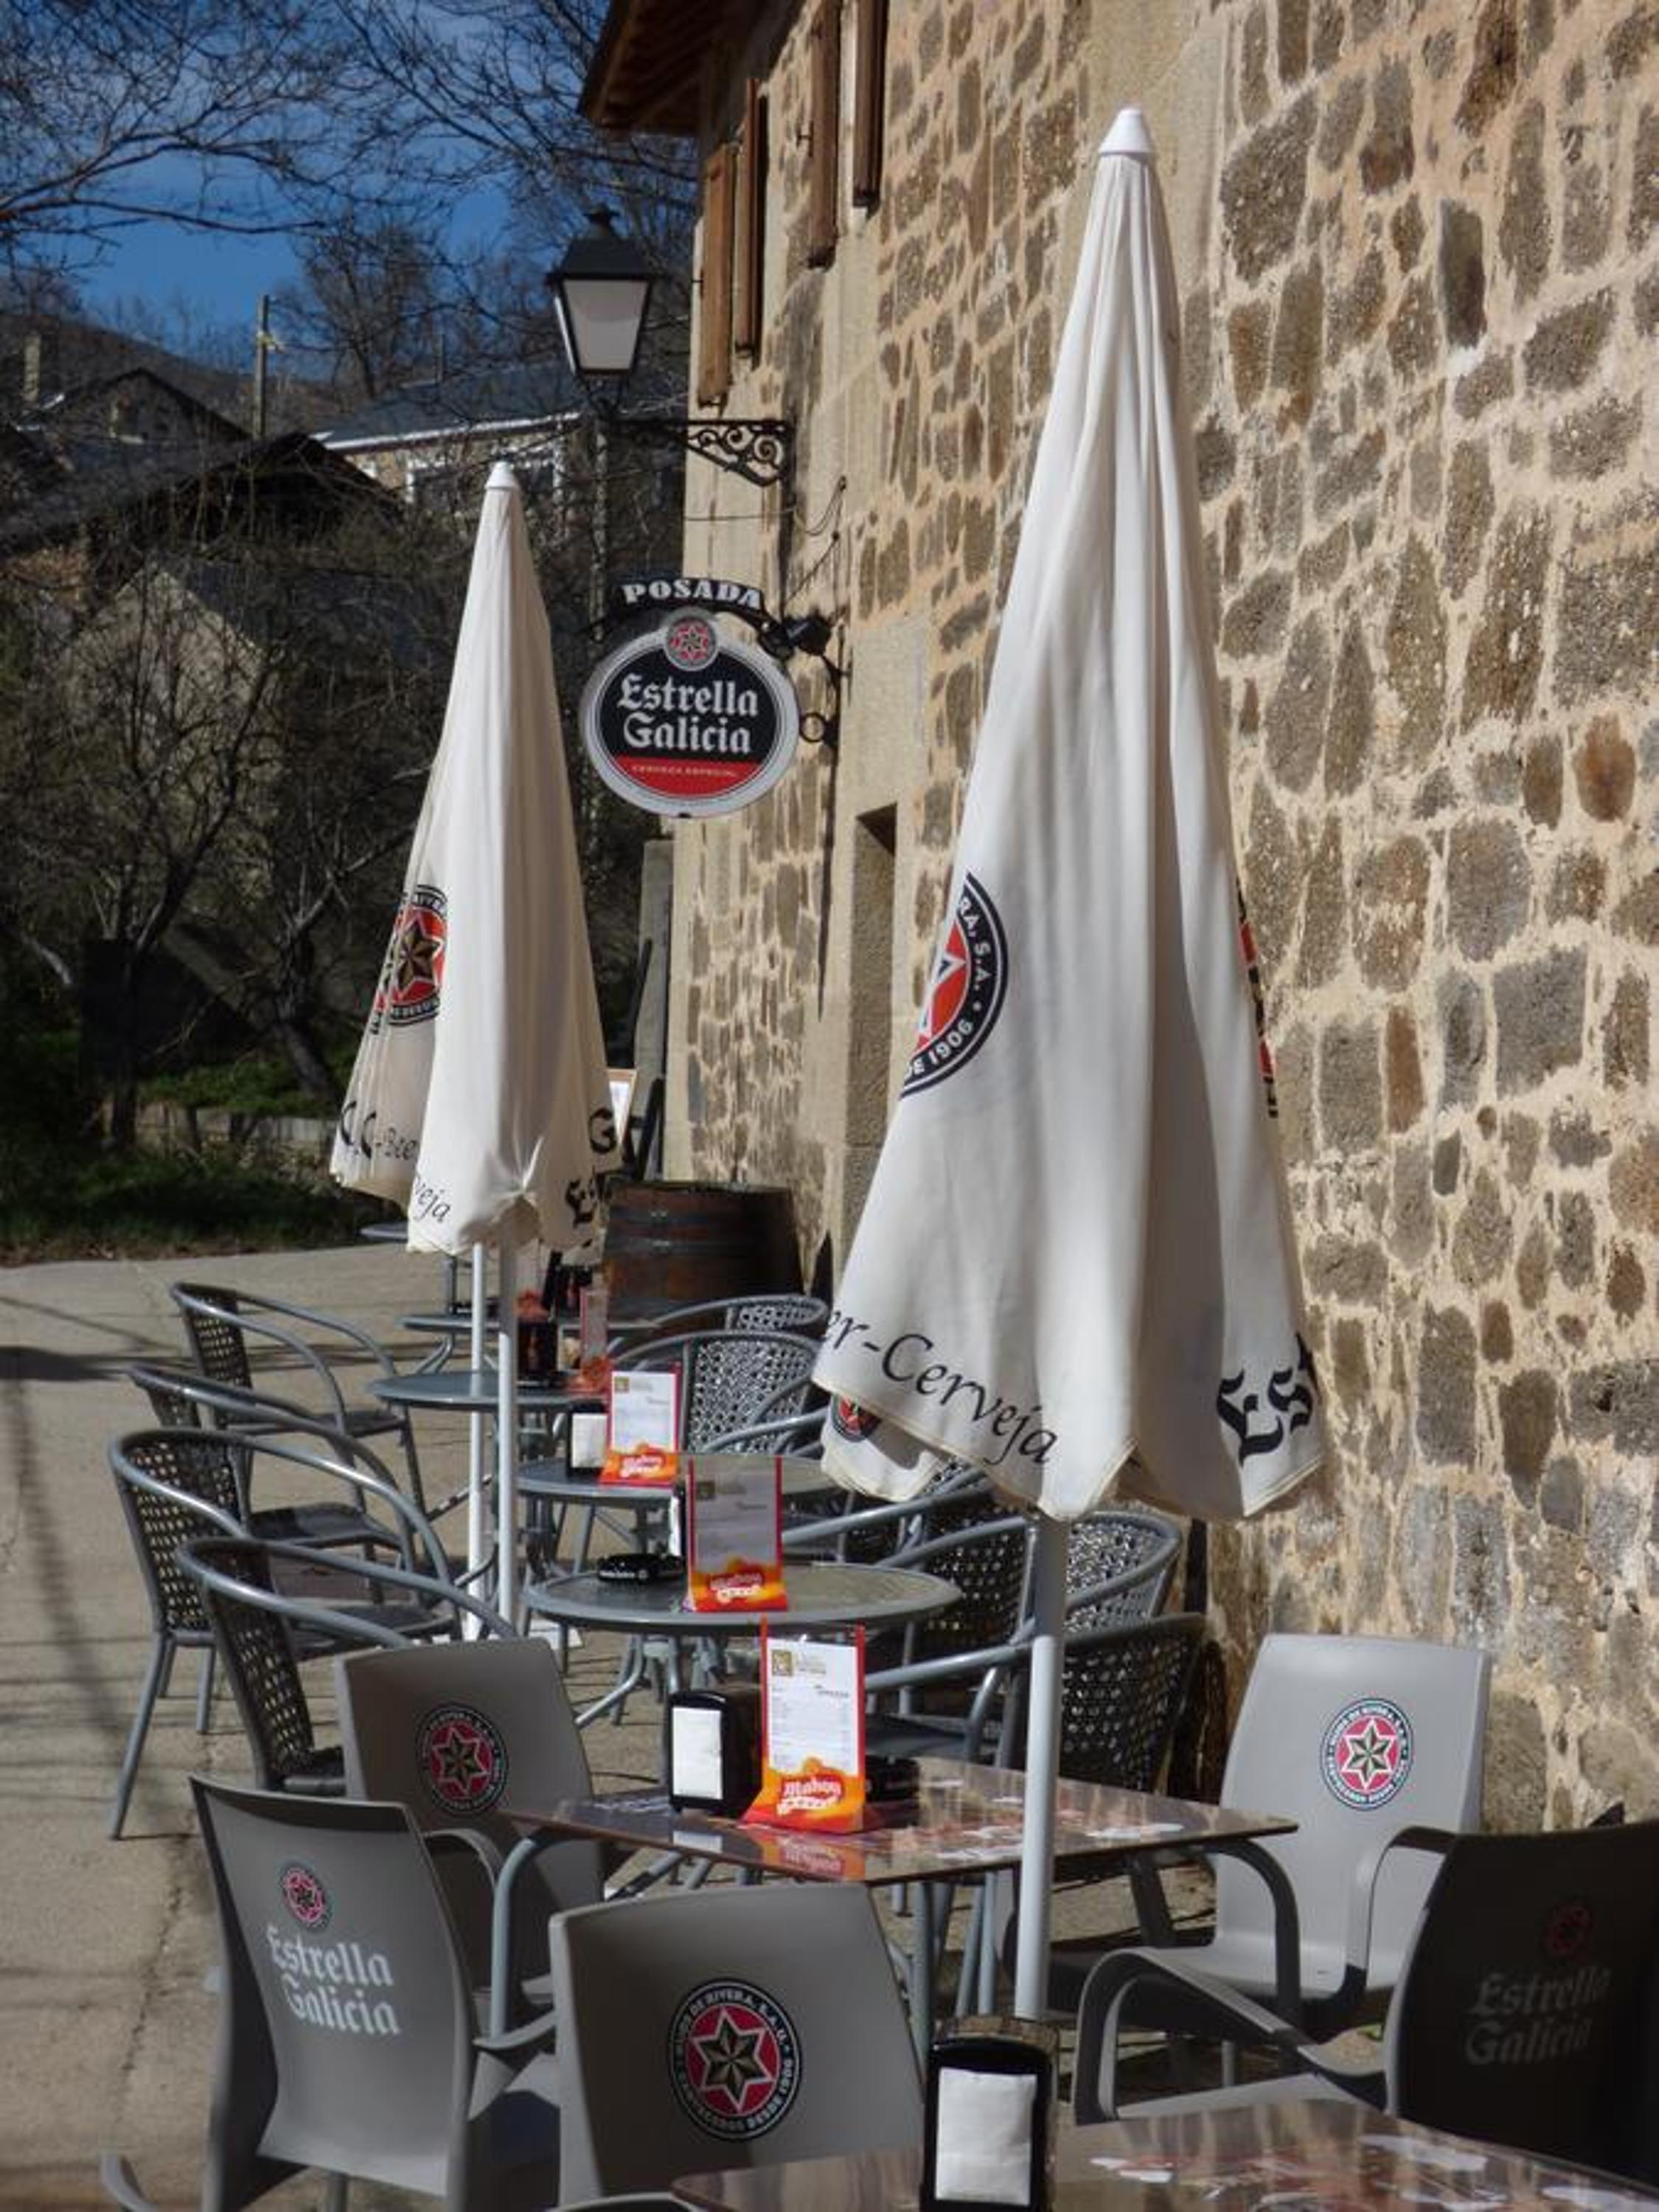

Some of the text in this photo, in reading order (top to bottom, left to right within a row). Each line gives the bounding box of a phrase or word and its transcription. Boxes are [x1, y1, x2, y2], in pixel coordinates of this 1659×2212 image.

[621, 579, 764, 611] POSADA
[616, 672, 759, 717] Estrella
[623, 712, 751, 754] Galicia
[265, 1923, 395, 1986] Estrella
[280, 1972, 400, 2035] Galicia
